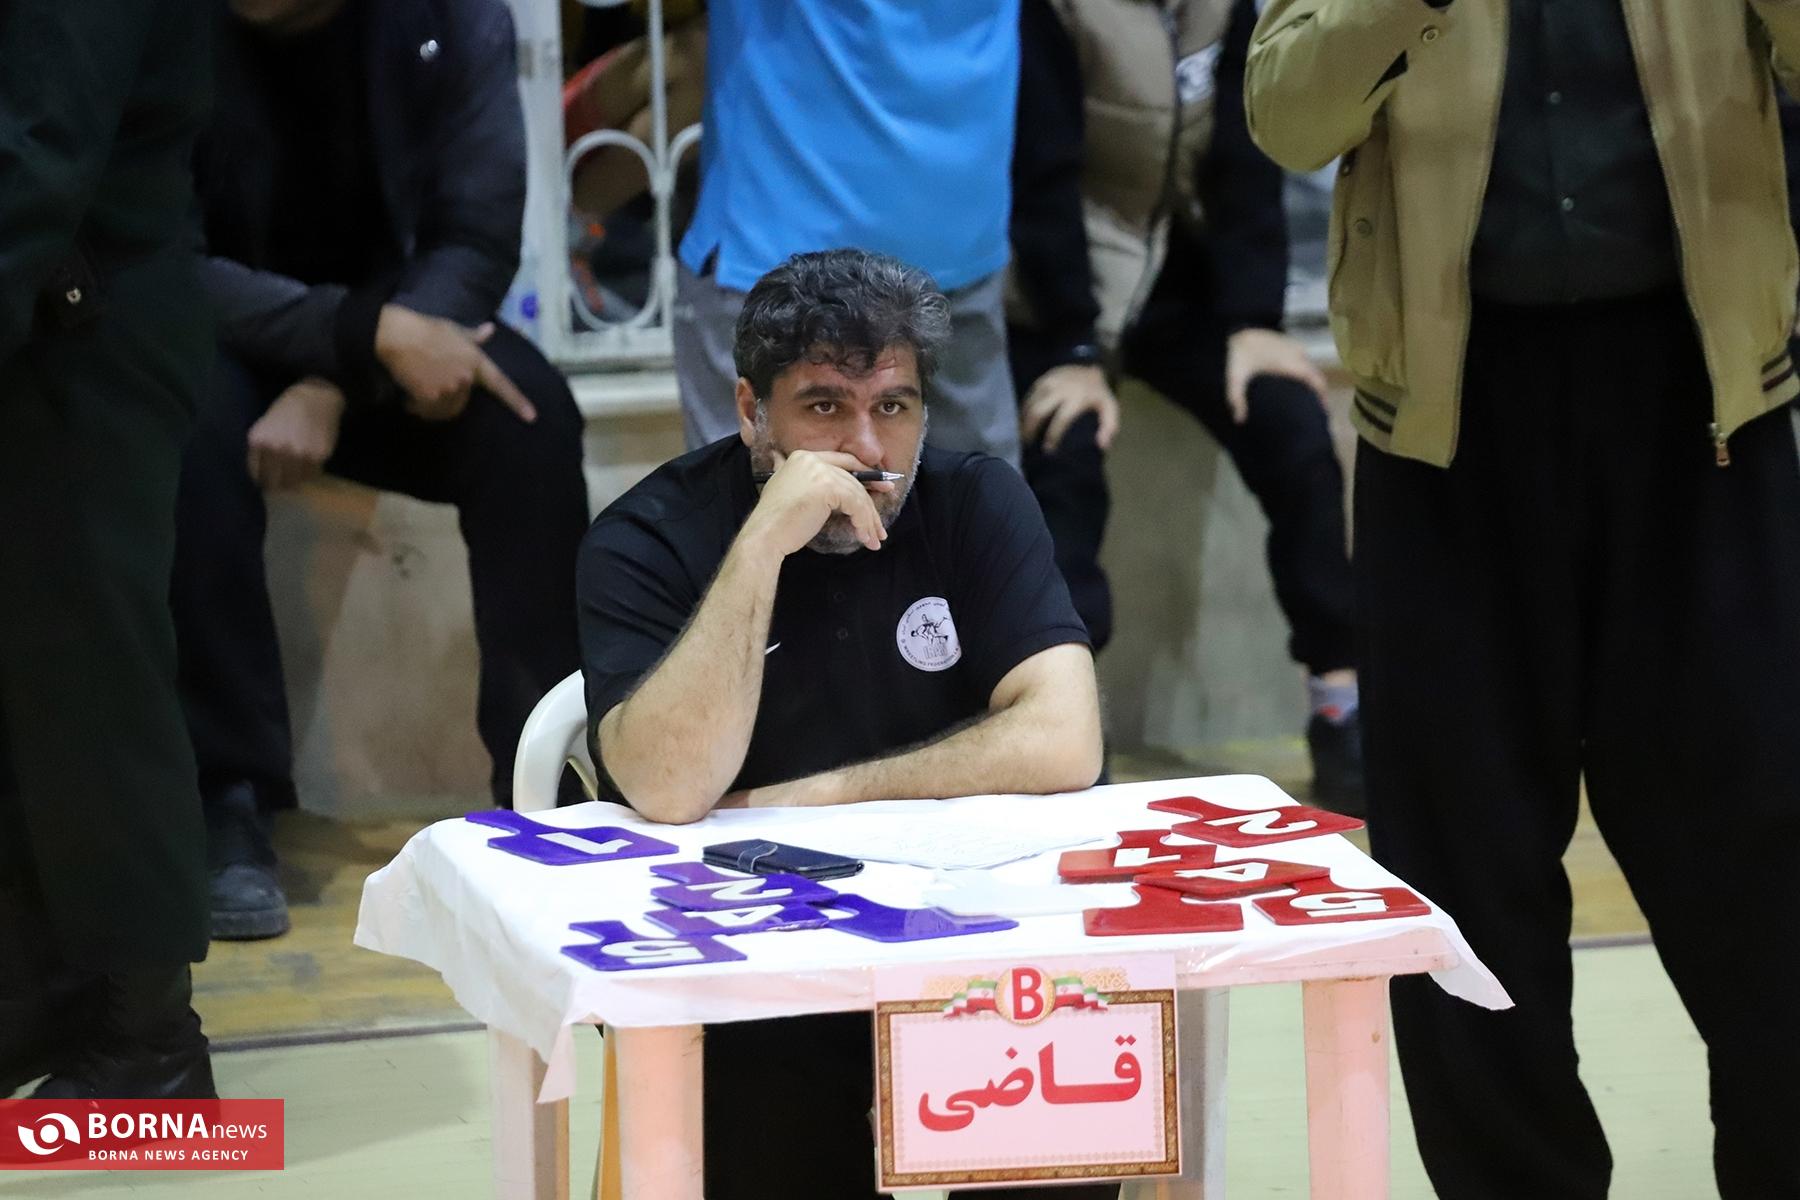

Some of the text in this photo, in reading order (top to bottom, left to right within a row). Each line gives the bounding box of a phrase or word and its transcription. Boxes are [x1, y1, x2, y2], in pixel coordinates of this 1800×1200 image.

[1203, 810, 1318, 835] 2
[536, 832, 633, 854] 1
[1113, 847, 1181, 868] 1
[1174, 861, 1270, 882] 4
[685, 878, 793, 901] 2
[682, 904, 785, 928] 4
[1289, 891, 1388, 918] 5
[600, 940, 705, 965] 5
[1012, 967, 1044, 1020] B
[918, 1034, 1142, 1132] قاضی
